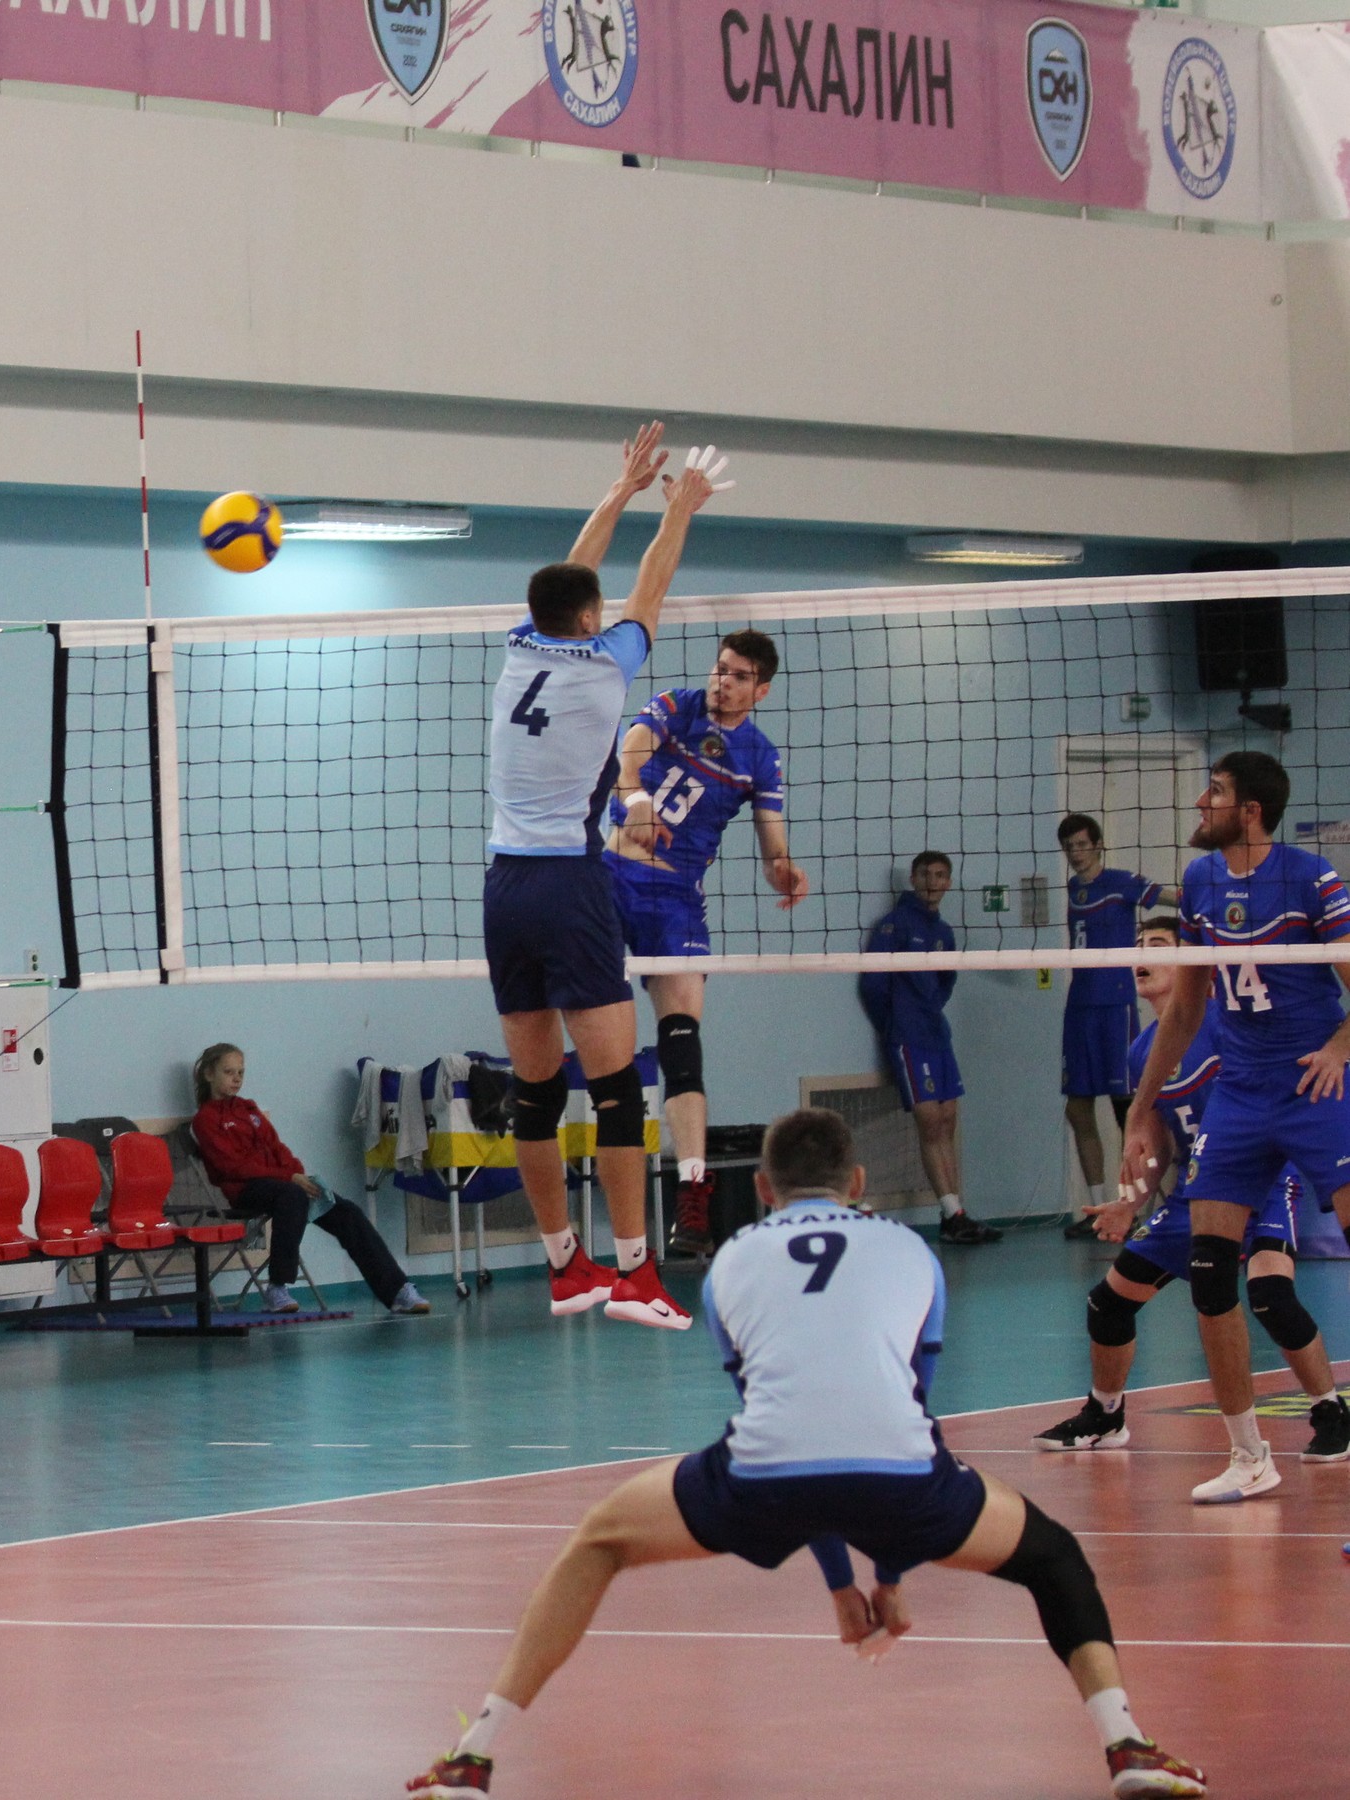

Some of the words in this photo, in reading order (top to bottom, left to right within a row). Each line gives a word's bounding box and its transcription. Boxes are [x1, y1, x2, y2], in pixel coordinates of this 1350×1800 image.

[720, 8, 954, 129] САХАЛИН
[563, 89, 622, 124] САХАЛИН
[510, 670, 552, 736] 4
[652, 764, 706, 827] 13
[1217, 962, 1273, 1013] 14
[787, 1231, 848, 1294] 9
